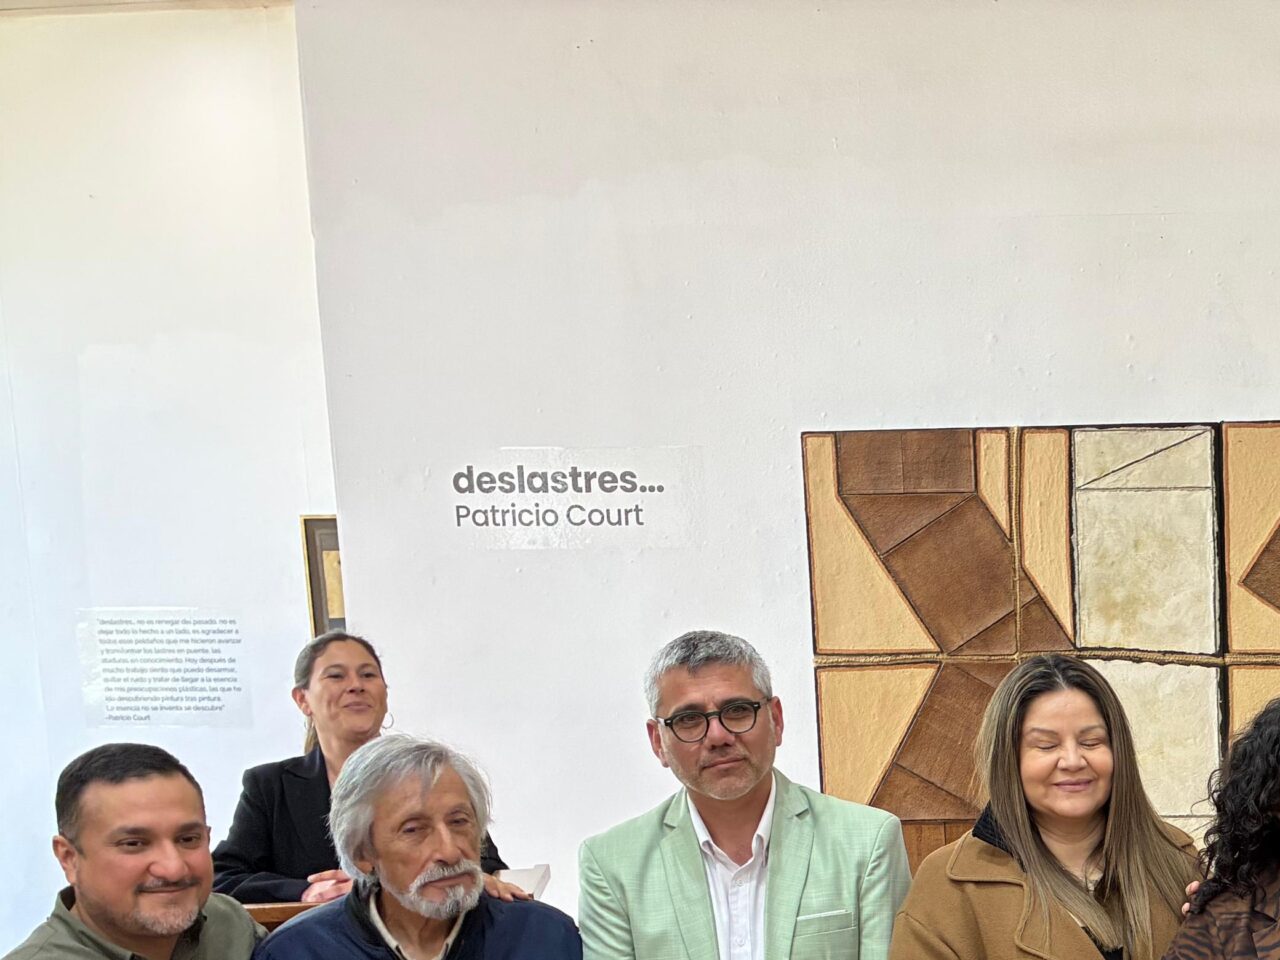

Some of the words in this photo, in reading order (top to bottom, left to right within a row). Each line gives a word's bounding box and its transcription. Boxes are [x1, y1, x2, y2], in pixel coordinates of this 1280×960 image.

[452, 465, 665, 494] deslastres...
[455, 502, 559, 527] Patricio
[566, 503, 644, 527] Court
